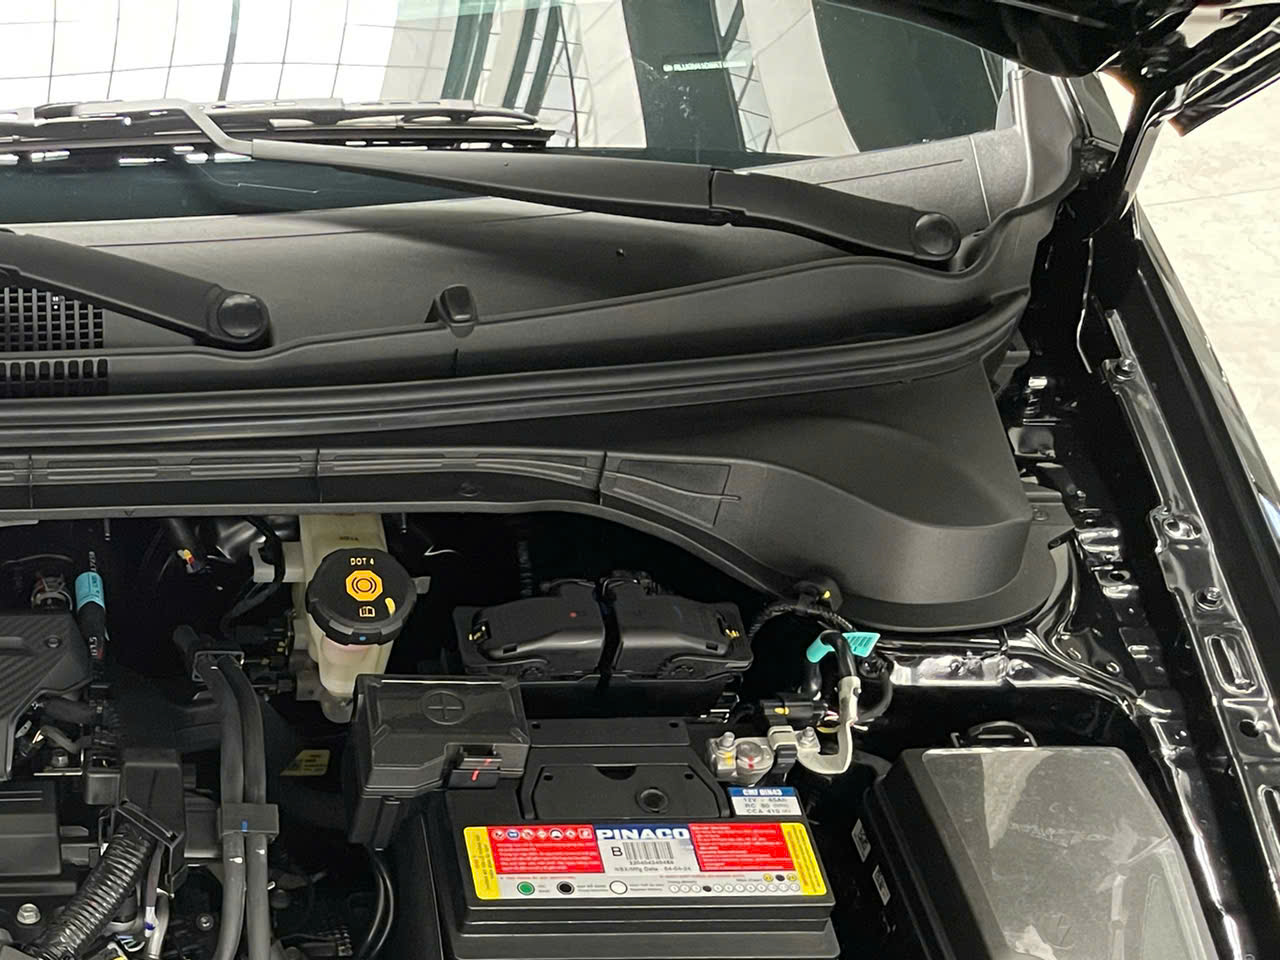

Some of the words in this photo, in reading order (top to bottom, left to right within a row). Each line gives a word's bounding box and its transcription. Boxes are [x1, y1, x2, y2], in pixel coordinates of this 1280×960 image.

[350, 557, 367, 566] DOT
[369, 557, 375, 566] 4
[595, 828, 691, 840] PINACO
[611, 847, 623, 857] B
